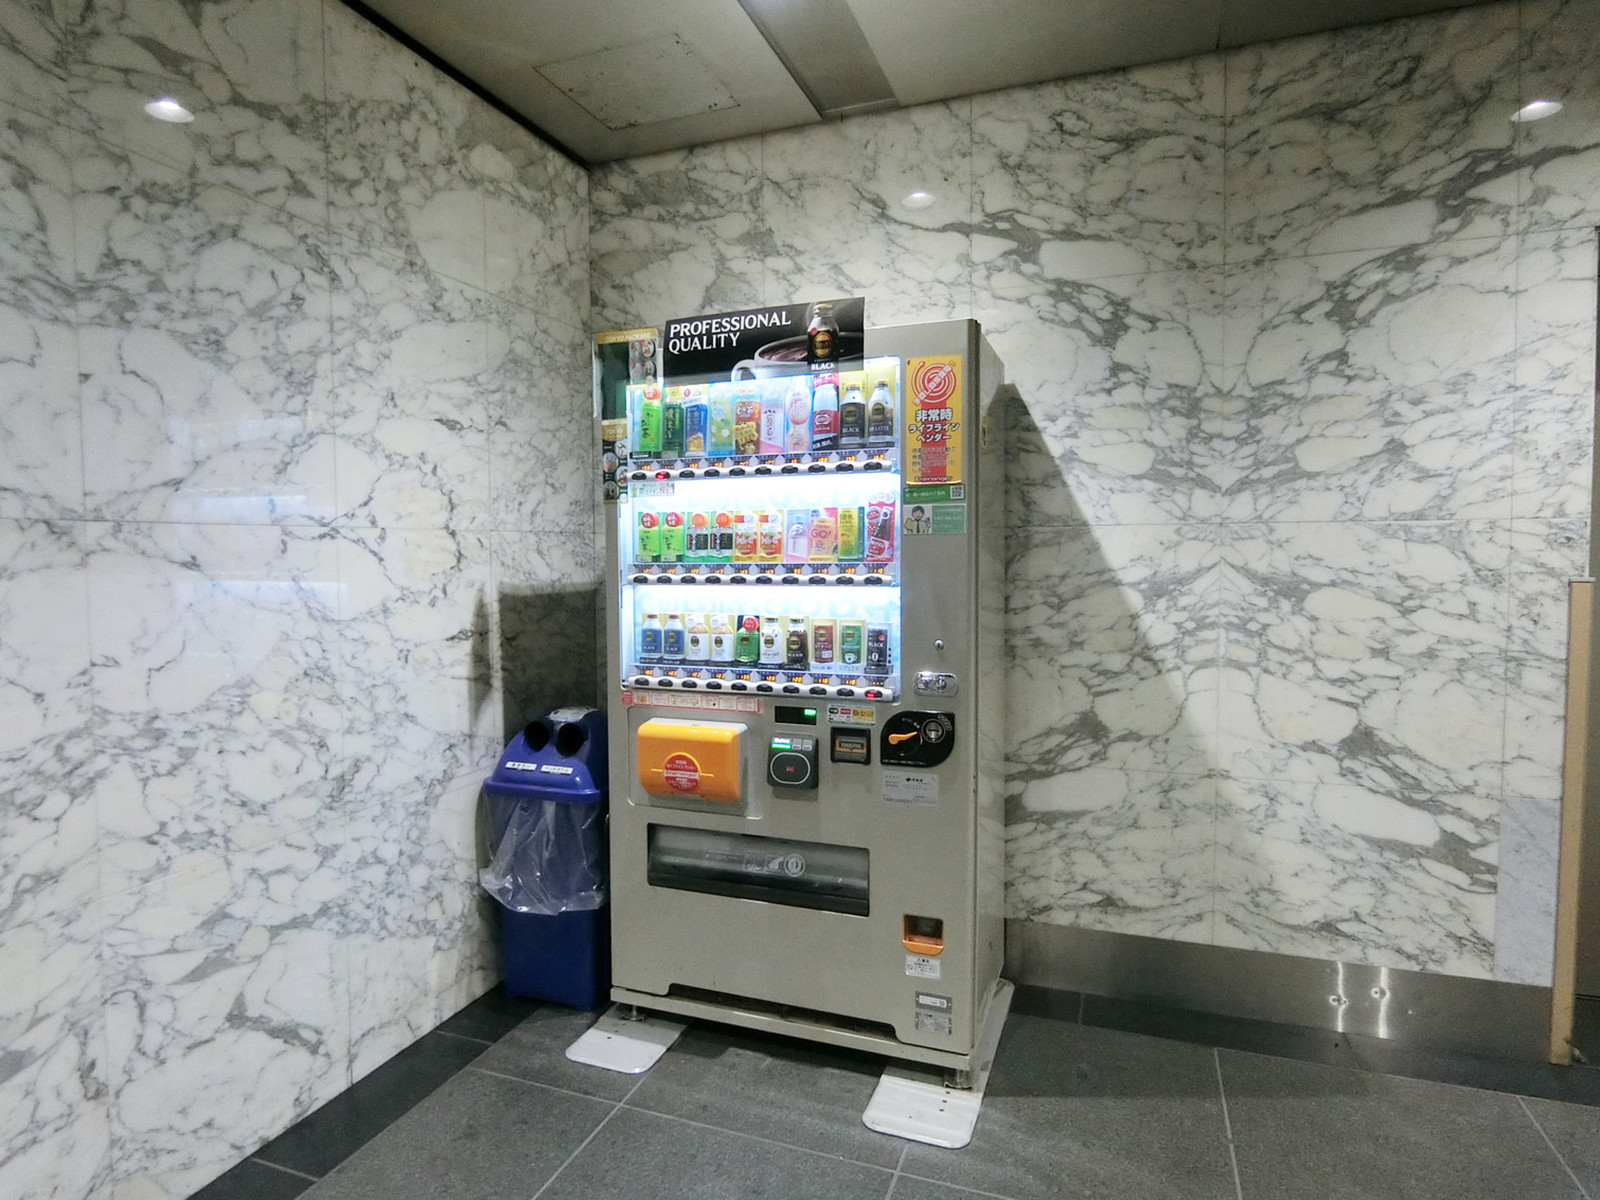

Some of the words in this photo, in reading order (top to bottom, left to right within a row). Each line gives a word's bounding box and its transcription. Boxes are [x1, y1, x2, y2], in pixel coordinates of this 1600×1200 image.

[669, 311, 791, 338] PROFESSIONAL
[668, 333, 740, 354] QUALITY
[811, 362, 835, 371] BLACK
[915, 408, 953, 422] 非常時
[908, 423, 960, 434] ライフライン
[917, 433, 952, 443] ベンダー
[811, 529, 832, 539] GO!
